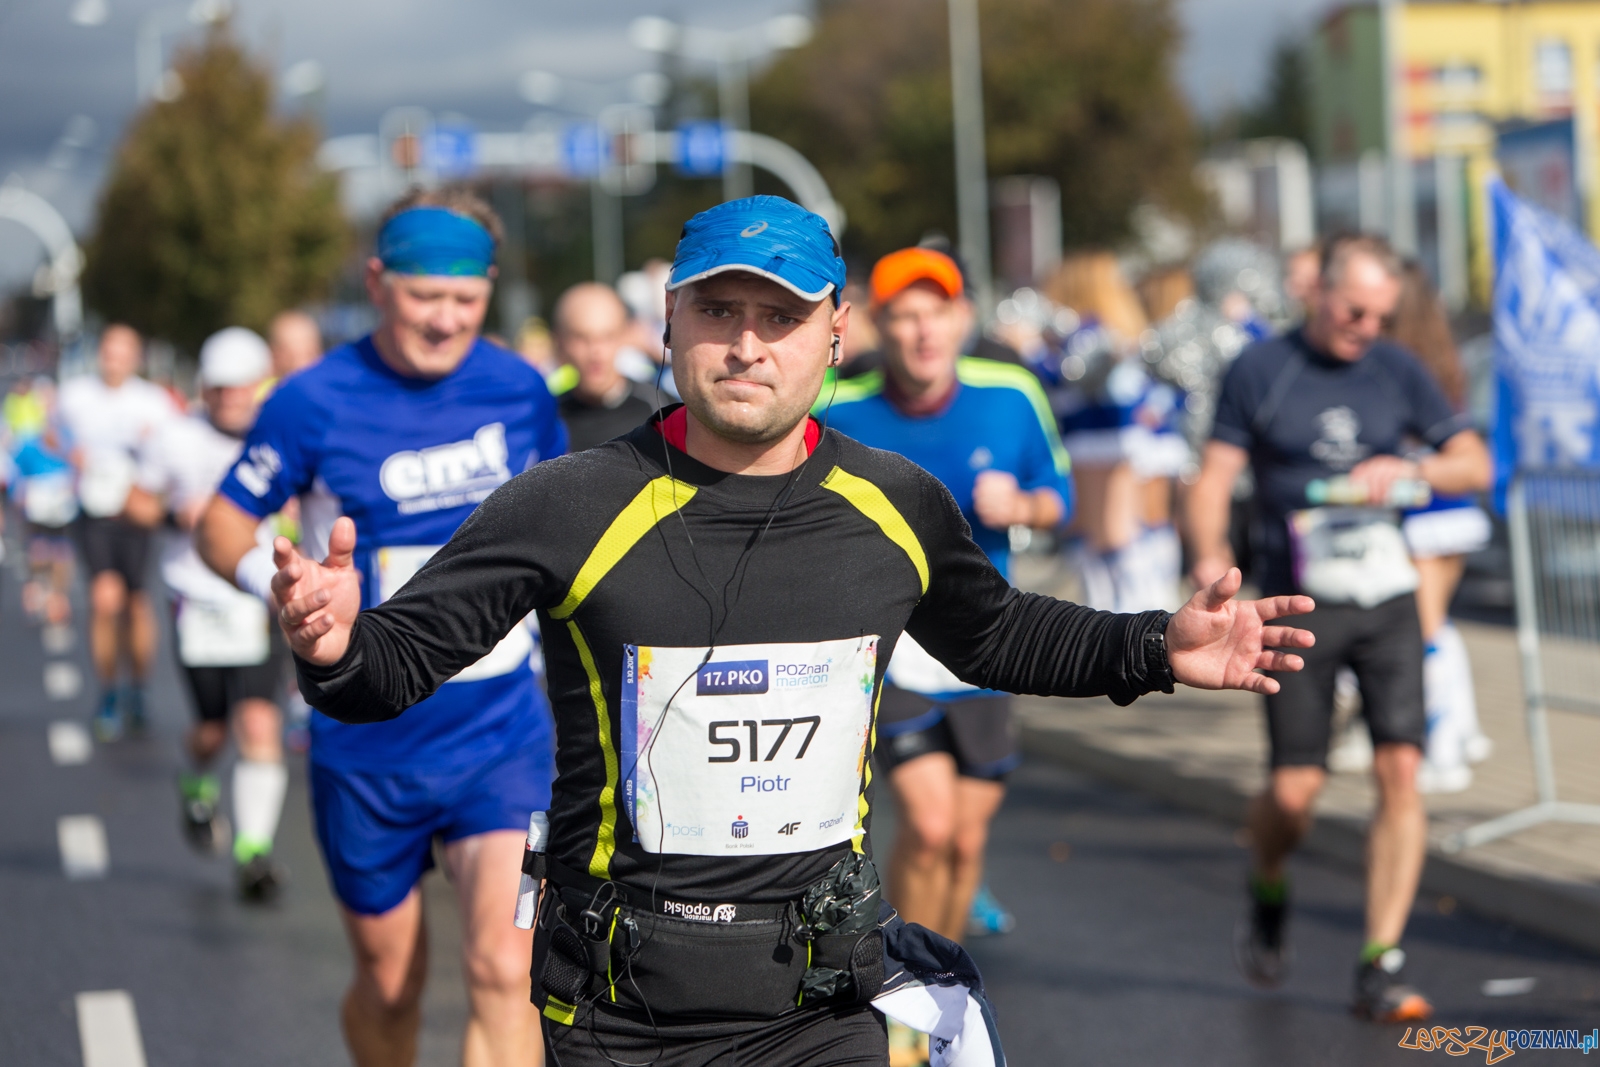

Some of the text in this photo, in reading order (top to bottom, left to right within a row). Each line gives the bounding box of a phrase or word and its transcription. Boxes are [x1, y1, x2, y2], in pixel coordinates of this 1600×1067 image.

[775, 674, 828, 687] maraton
[707, 715, 821, 764] 5177
[740, 774, 791, 793] Piotr
[672, 824, 705, 837] posir
[778, 821, 801, 835] 4F
[664, 900, 711, 916] opolski
[684, 913, 712, 921] maraton
